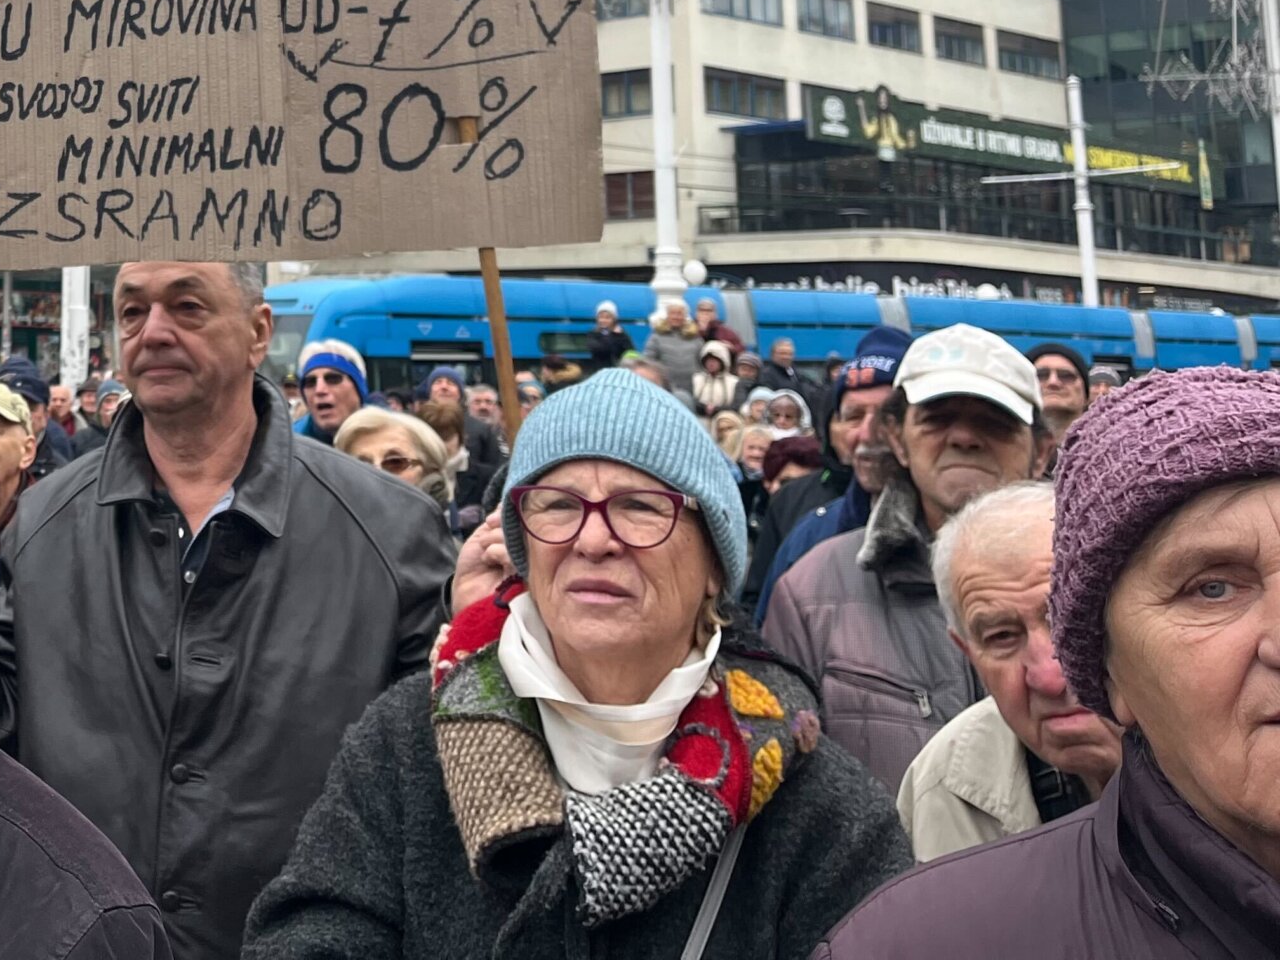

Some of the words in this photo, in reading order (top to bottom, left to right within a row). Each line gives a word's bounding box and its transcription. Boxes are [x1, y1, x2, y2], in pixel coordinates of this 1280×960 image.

[57, 124, 285, 184] MINIMALNI
[320, 76, 538, 181] 80%
[108, 75, 200, 130] SVITI
